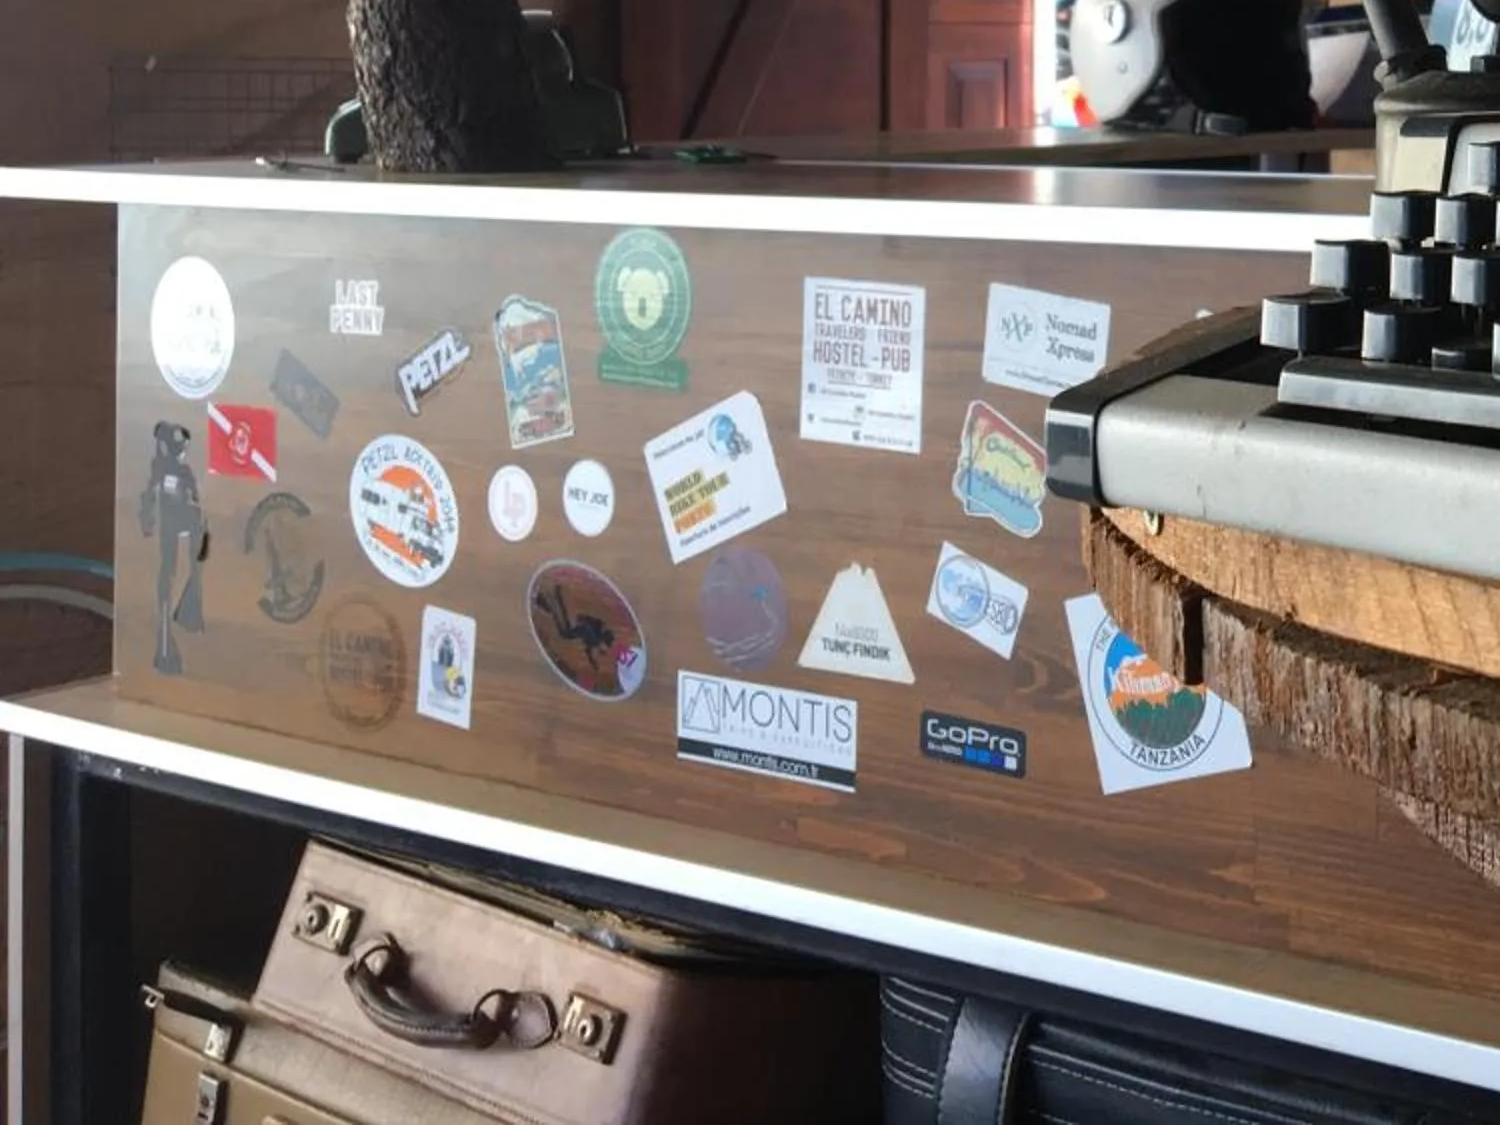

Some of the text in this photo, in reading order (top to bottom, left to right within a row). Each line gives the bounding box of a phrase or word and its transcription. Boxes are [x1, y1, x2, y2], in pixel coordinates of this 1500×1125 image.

[335, 279, 379, 306] LAST
[330, 306, 385, 336] PENNY
[814, 292, 912, 329] EL CAMINO
[1045, 312, 1098, 341] Nomad
[812, 340, 868, 369] HOSTEL
[880, 347, 912, 374] PUB
[1045, 335, 1096, 365] Xpress
[568, 487, 609, 507] HEY JOE
[721, 684, 853, 744] MONTIS
[927, 718, 1019, 755] GoPro
[1128, 733, 1206, 767] TANZANIA
